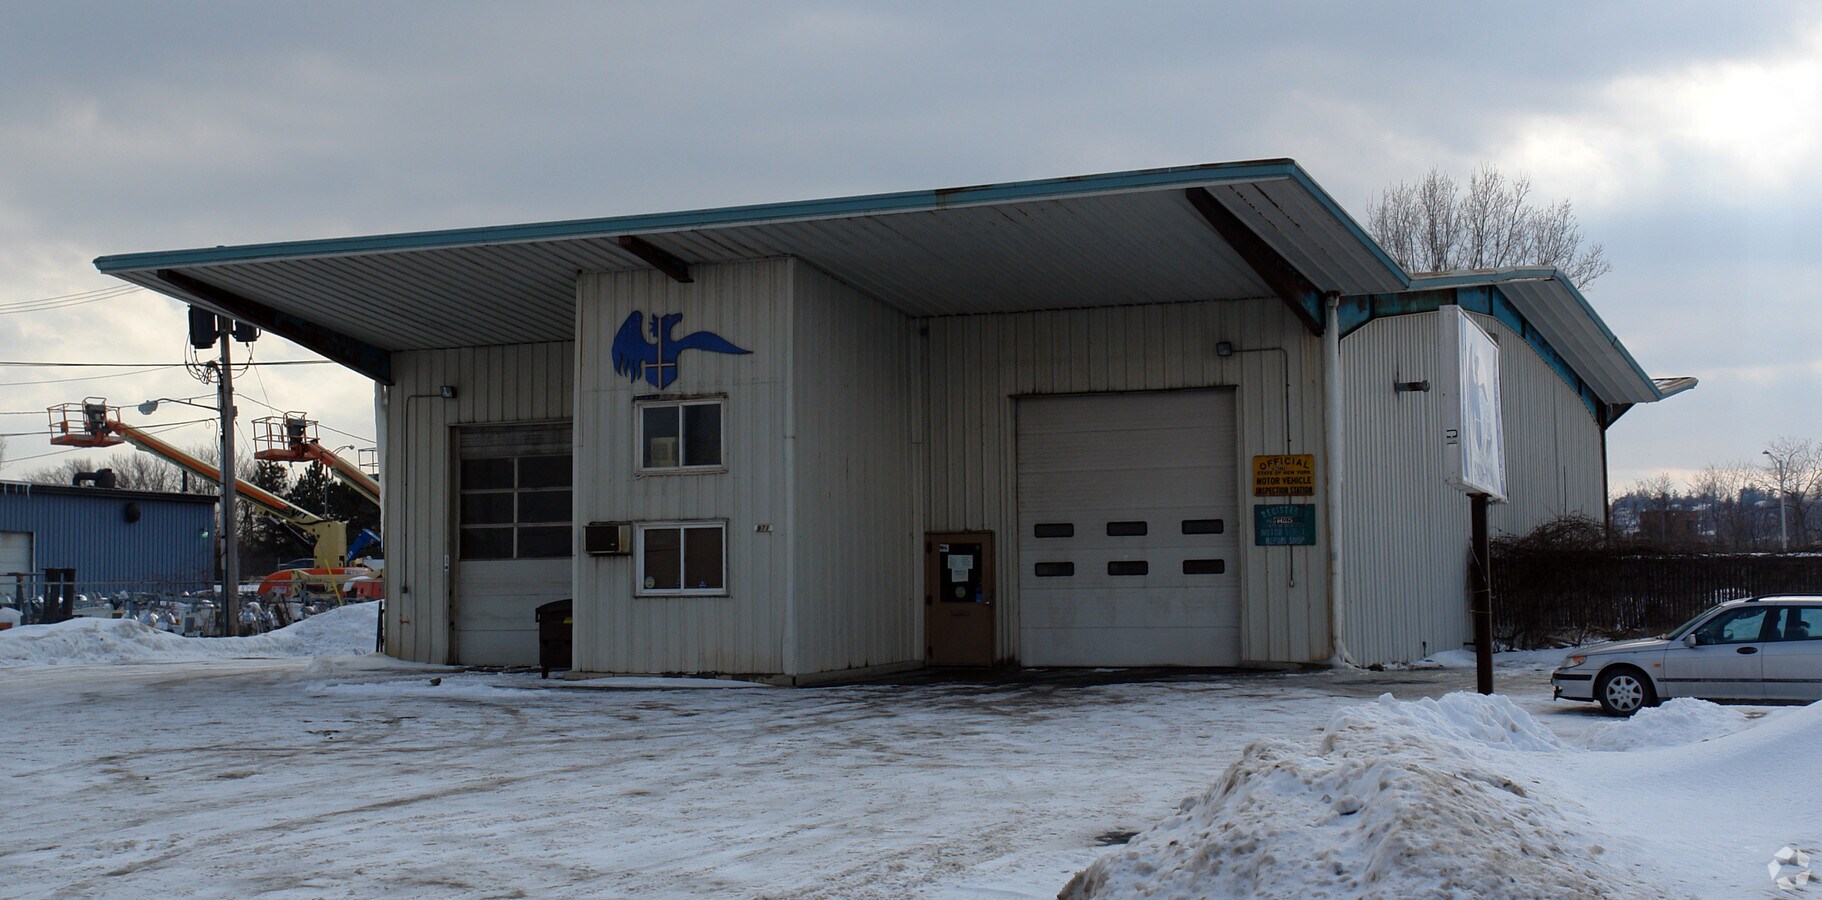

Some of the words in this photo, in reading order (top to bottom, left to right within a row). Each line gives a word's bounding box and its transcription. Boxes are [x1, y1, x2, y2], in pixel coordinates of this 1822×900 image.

[1259, 457, 1310, 470] OFFICIAL
[1256, 476, 1280, 485] MOTOR
[1282, 476, 1312, 485] VEHICLE
[1256, 486, 1288, 495] INSPECTION
[1290, 486, 1313, 494] STATION
